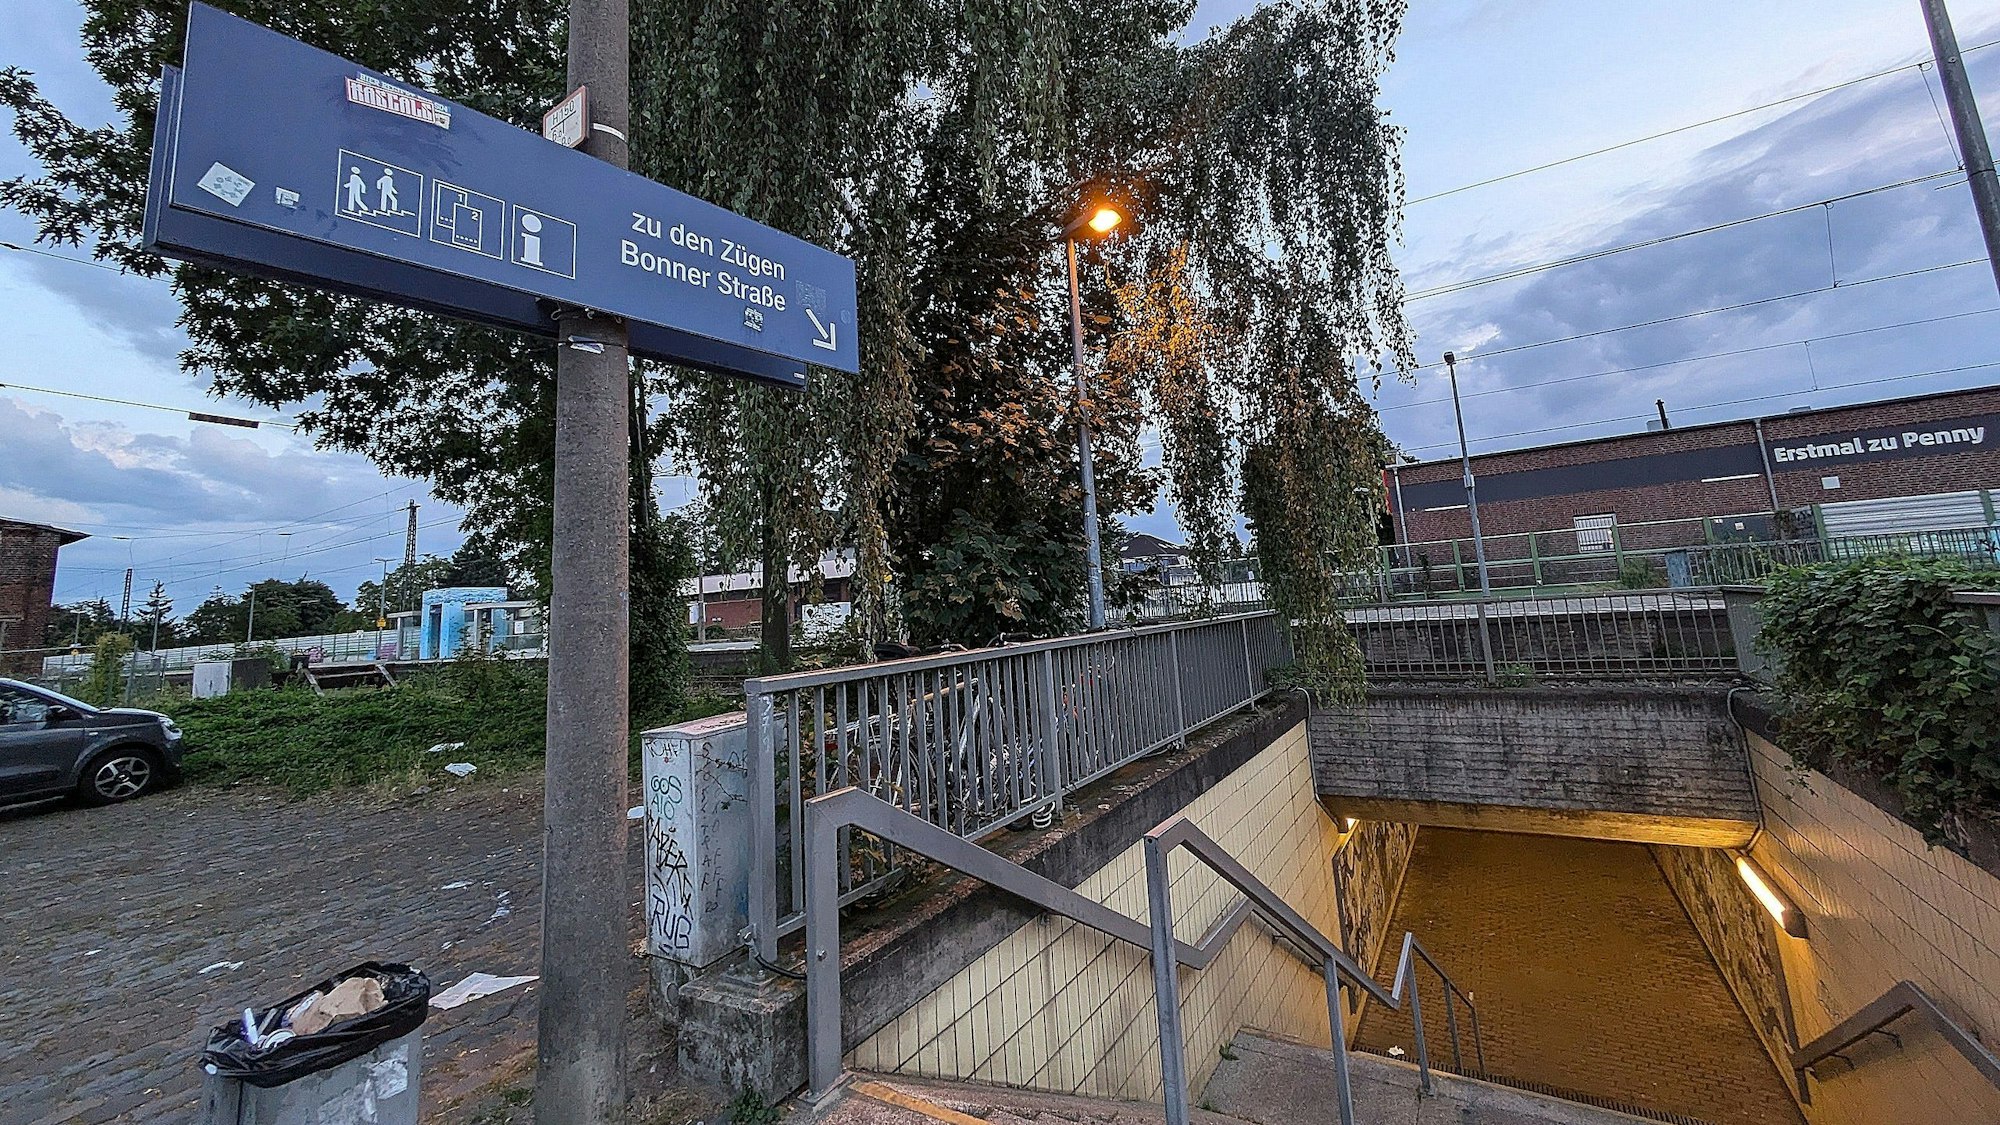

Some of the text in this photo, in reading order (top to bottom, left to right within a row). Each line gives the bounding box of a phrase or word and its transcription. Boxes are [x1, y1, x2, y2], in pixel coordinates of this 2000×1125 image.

[350, 82, 433, 121] RASCALS
[552, 100, 574, 126] H150
[632, 211, 785, 281] zu den Zügen
[621, 239, 711, 288] Bonner
[717, 272, 786, 311] Straße
[1774, 426, 1985, 463] Erstmal zu Penny
